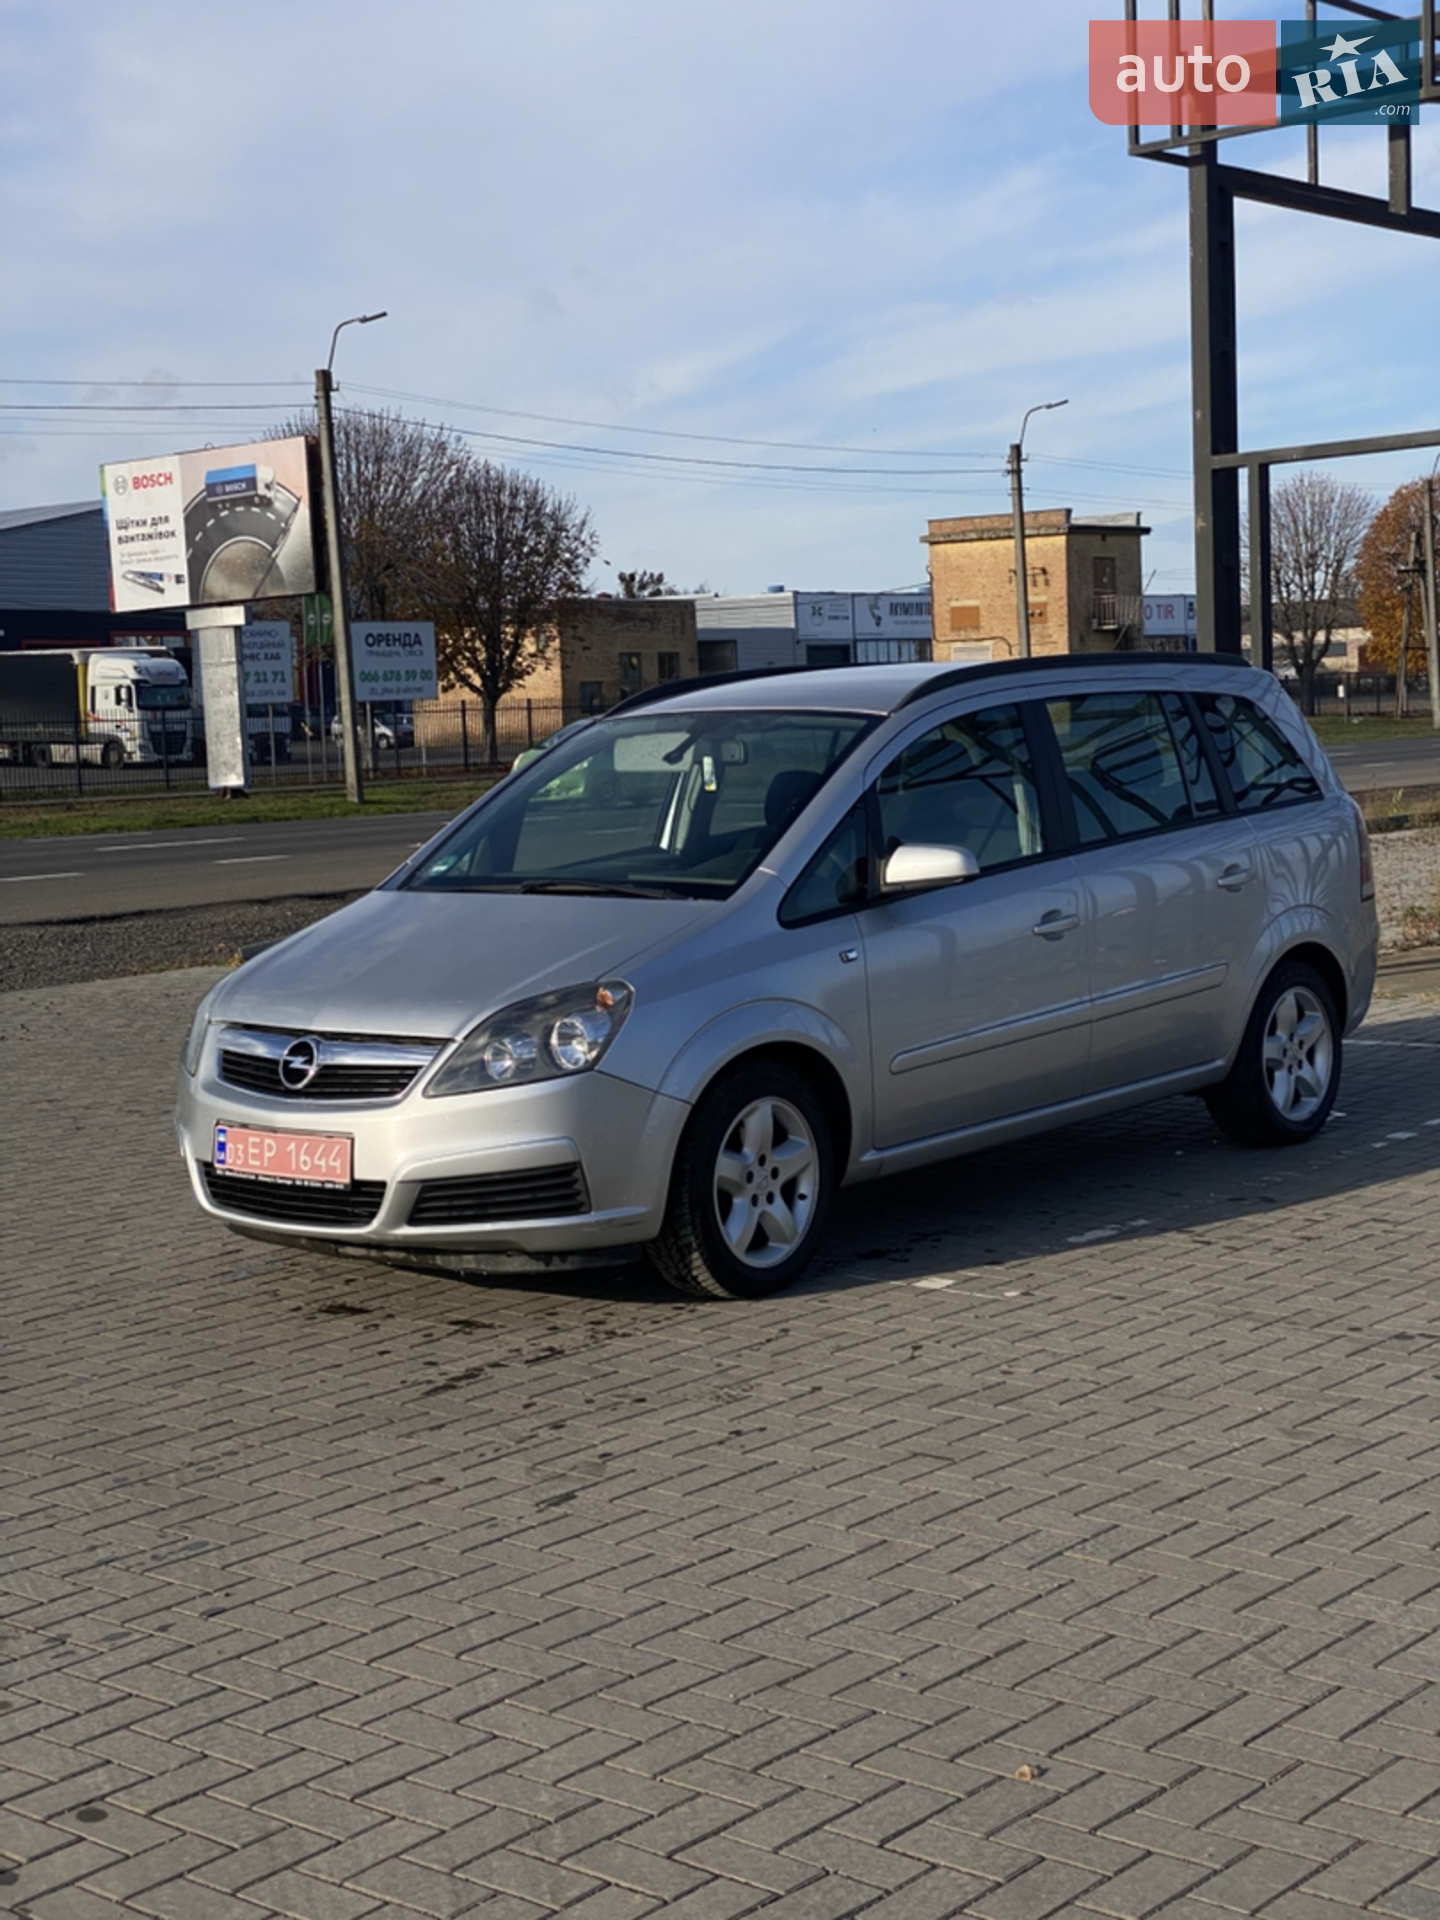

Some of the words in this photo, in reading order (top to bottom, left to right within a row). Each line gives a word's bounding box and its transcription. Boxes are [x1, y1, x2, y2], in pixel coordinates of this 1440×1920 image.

[132, 471, 173, 490] BOSCH
[224, 482, 247, 493] BOSCH
[115, 517, 147, 531] Щітки
[150, 515, 170, 527] для
[117, 529, 177, 545] вантажівок
[1155, 604, 1174, 619] TIR
[364, 632, 423, 650] ОРЕНДА
[263, 652, 281, 661] ХАБ
[254, 670, 269, 684] 21
[271, 670, 287, 683] 71
[359, 670, 379, 684] 066
[419, 668, 433, 682] 00
[286, 1141, 342, 1175] 1644
